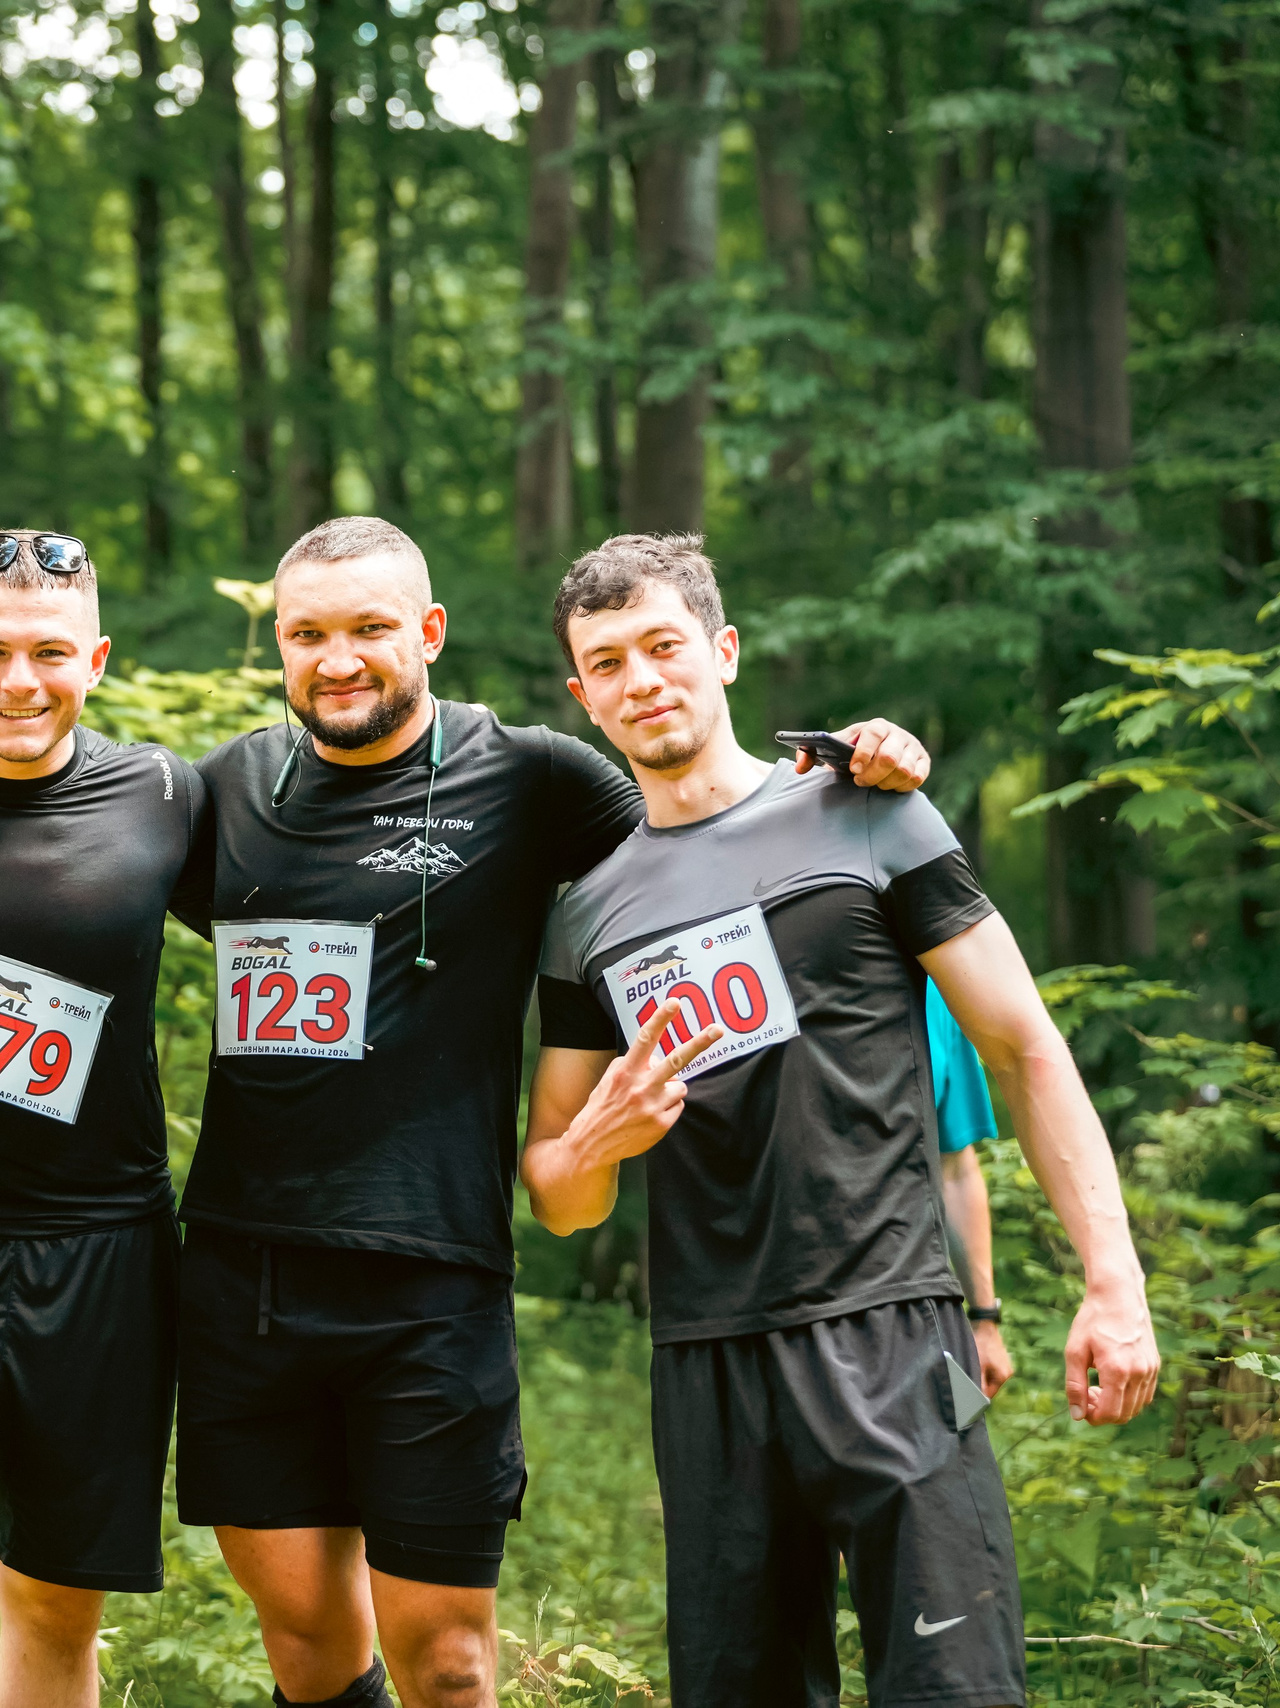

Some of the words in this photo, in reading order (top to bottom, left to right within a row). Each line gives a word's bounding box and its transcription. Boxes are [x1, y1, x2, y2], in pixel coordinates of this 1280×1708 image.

[160, 760, 173, 800] Reebok
[373, 815, 394, 827] ТАМ
[442, 819, 474, 831] ГОРЫ
[231, 956, 291, 970] BOGAL
[626, 963, 691, 1004] BOGAL
[231, 971, 351, 1044] 123
[225, 1045, 270, 1054] СПОРТИВНЫЙ
[272, 1046, 325, 1056] МАРАФОН
[328, 1049, 349, 1057] 2026
[709, 1034, 762, 1061] МАРАФОН
[763, 1026, 784, 1039] 2026
[41, 1104, 61, 1117] 2026
